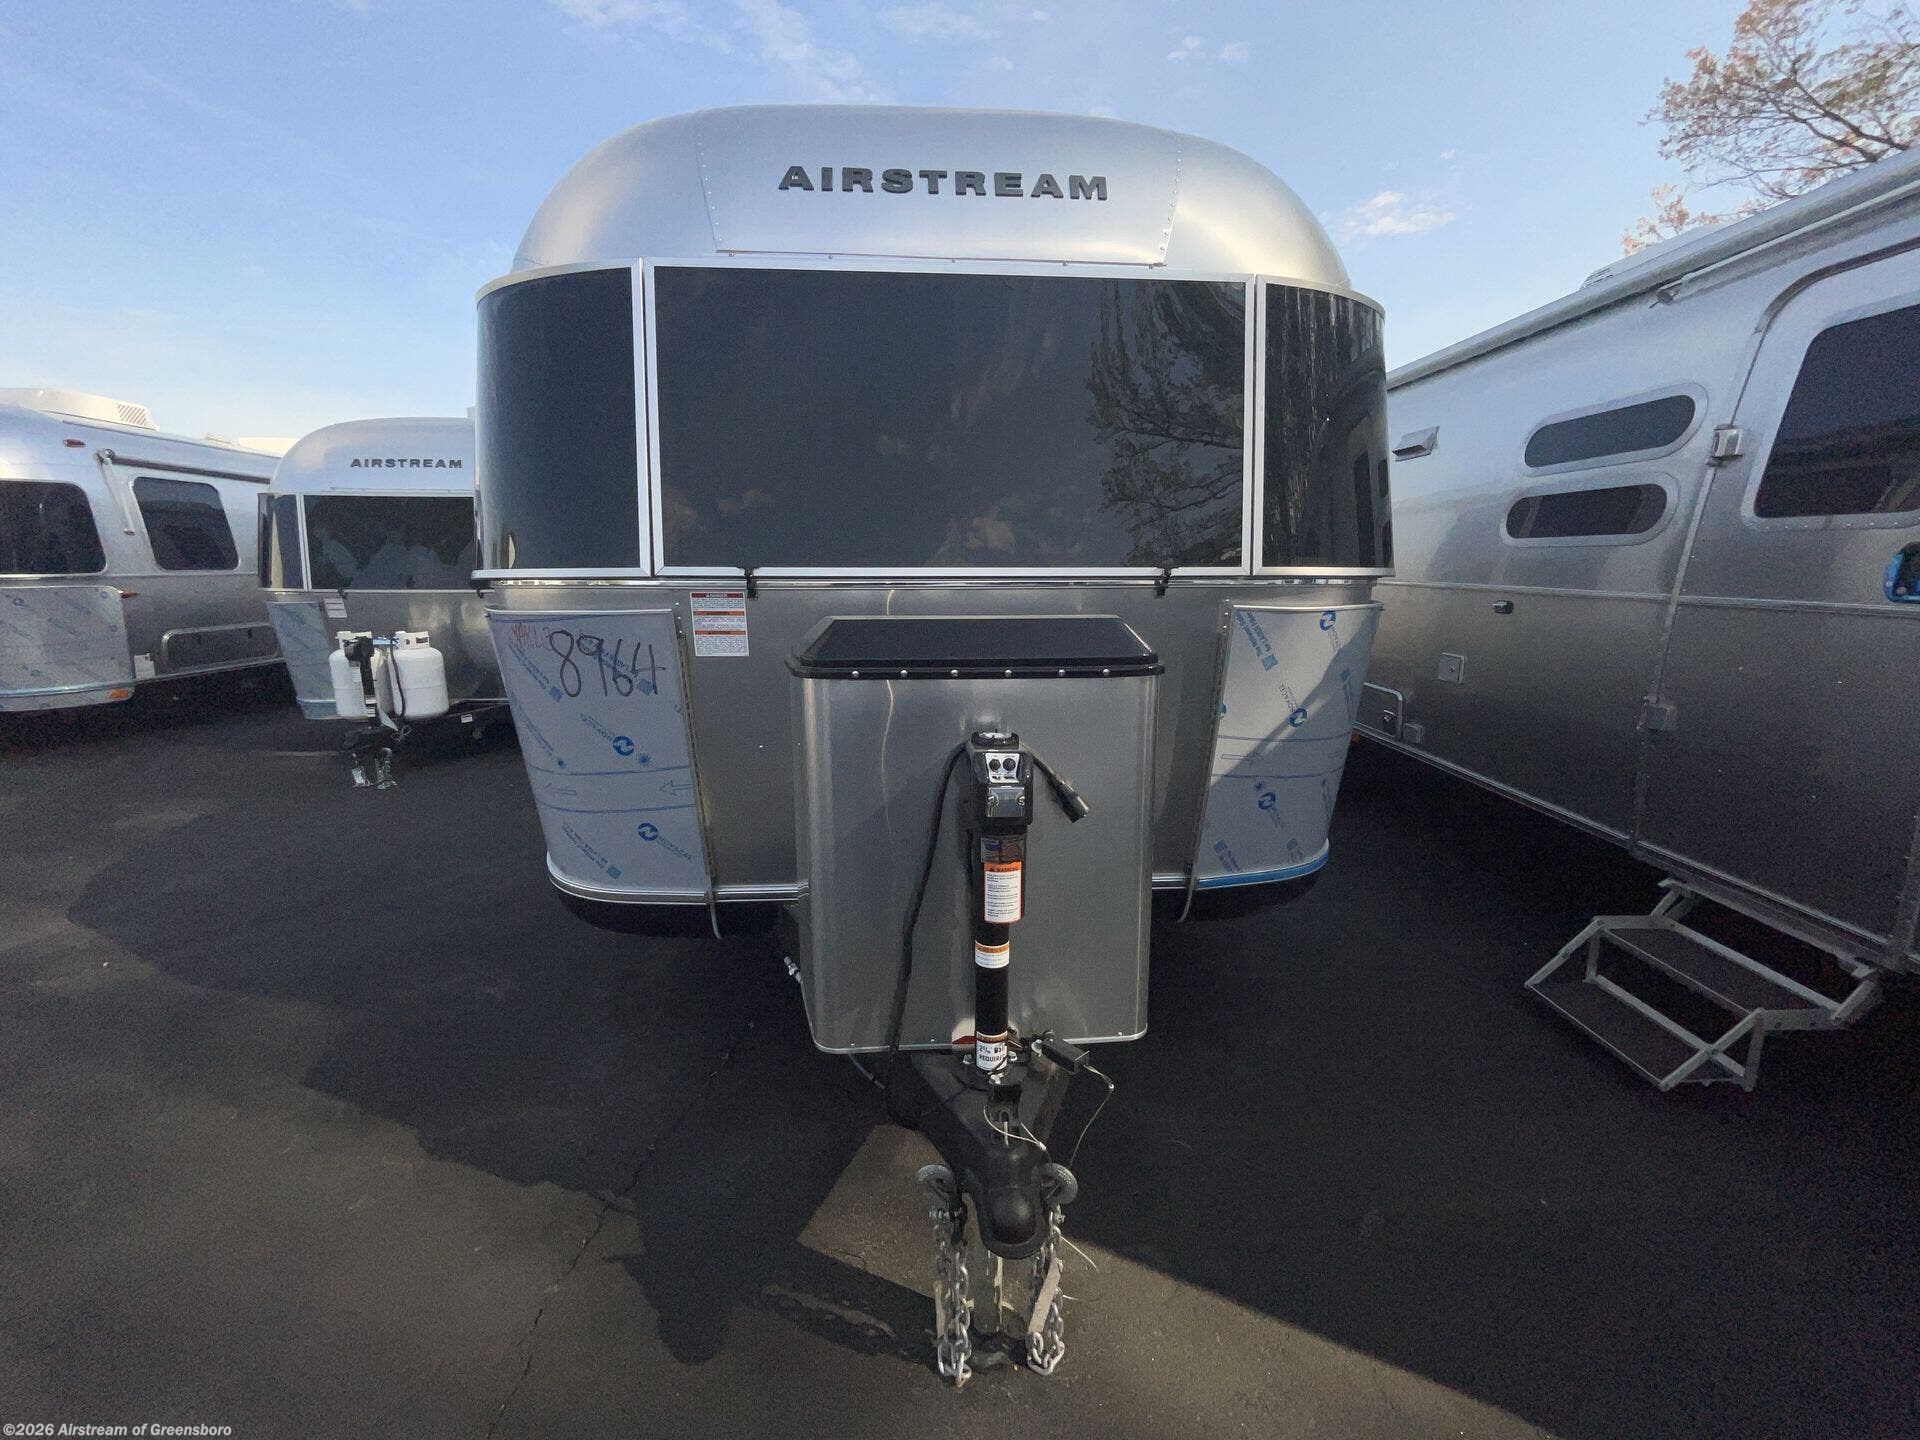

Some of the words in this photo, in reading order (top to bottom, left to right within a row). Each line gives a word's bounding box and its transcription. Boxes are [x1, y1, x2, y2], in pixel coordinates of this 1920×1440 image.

[778, 165, 1108, 201] AIRSTREAM
[350, 458, 462, 469] AIRSTREAM
[550, 629, 667, 698] 8964
